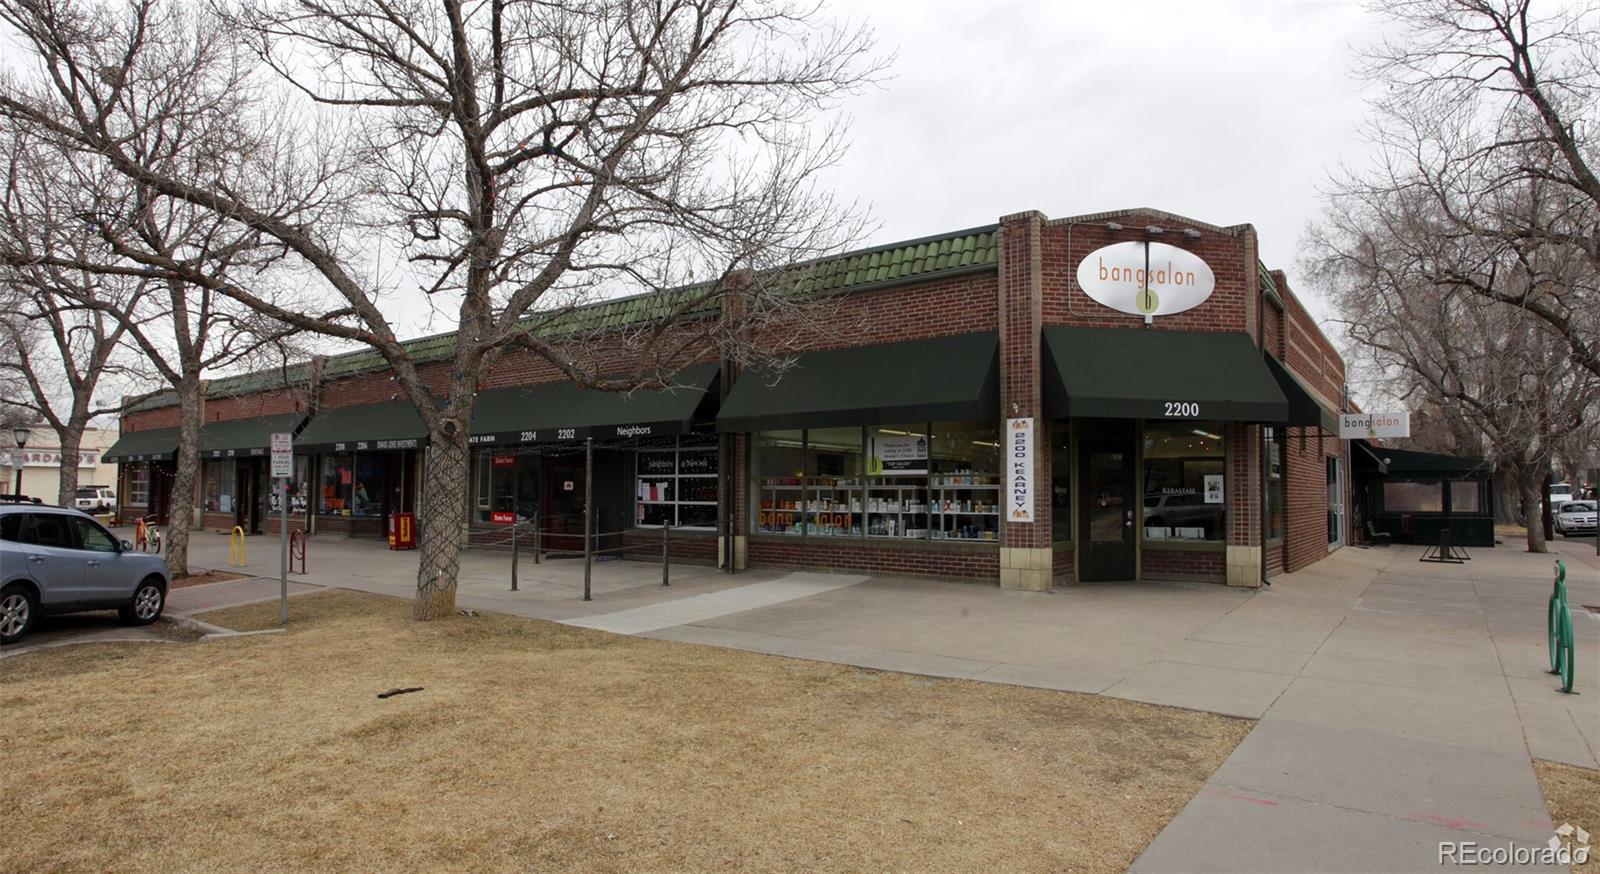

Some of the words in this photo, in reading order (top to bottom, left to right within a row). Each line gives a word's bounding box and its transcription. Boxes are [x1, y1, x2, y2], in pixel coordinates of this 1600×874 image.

[1164, 402, 1199, 417] 2200
[521, 431, 537, 441] 2204
[558, 429, 575, 440] 2202
[616, 425, 651, 438] Neighbors
[480, 435, 495, 443] FARM
[1014, 432, 1026, 458] 2200
[1014, 462, 1027, 508] KEARNEY
